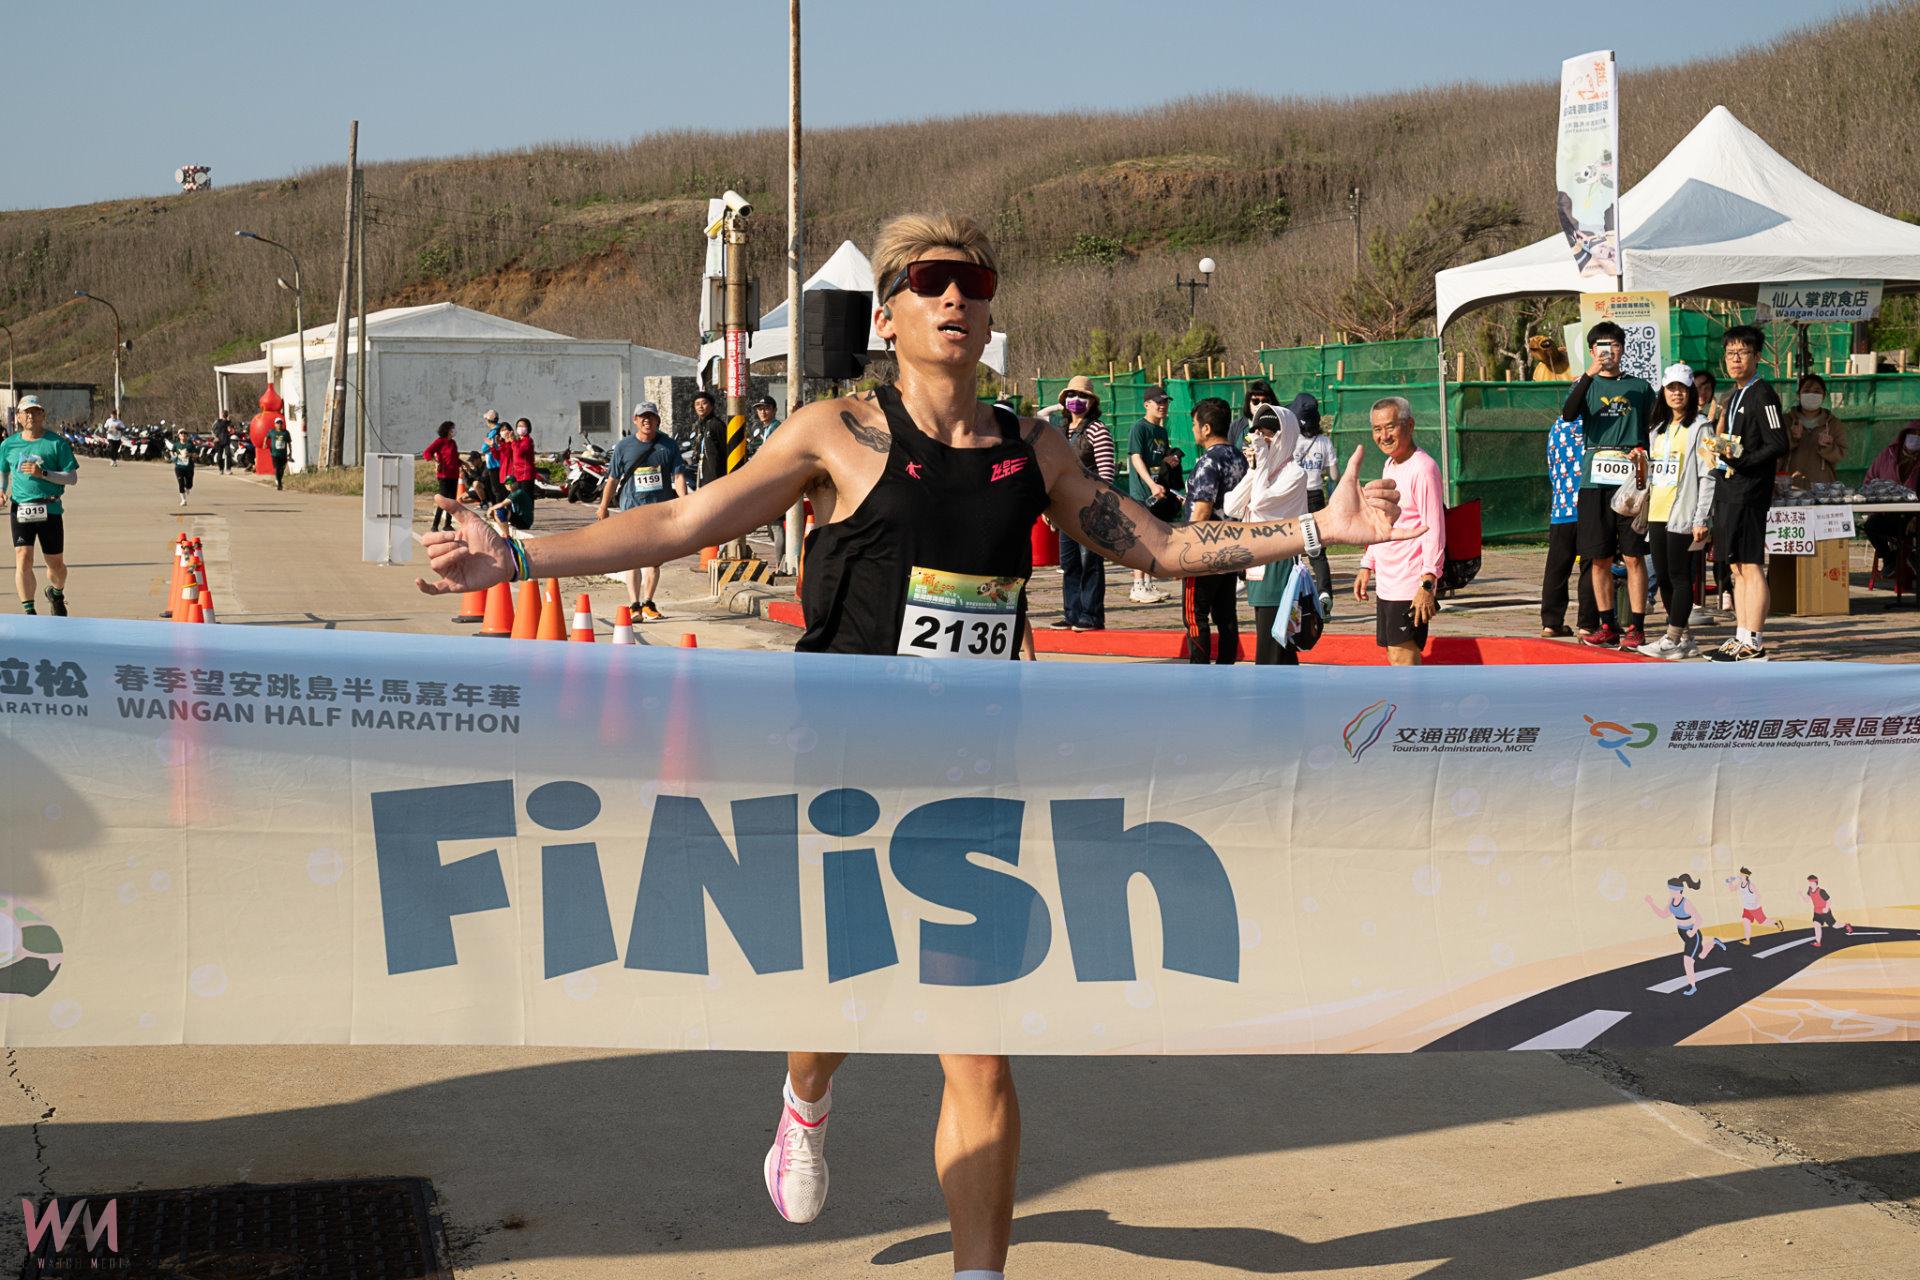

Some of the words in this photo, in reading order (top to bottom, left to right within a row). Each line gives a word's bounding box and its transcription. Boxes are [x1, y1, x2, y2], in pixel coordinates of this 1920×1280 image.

[1772, 290, 1869, 308] 仙人掌飲食店
[1775, 309, 1815, 319] Wangan
[1816, 308, 1838, 317] local
[1841, 307, 1862, 317] food
[1596, 463, 1629, 475] 1008
[637, 475, 660, 483] 1159
[910, 615, 1008, 655] 2136
[115, 664, 521, 708] 春季望安跳島半馬嘉年華
[117, 697, 254, 723] WANGAN
[265, 704, 342, 727] HALF
[351, 708, 520, 734] MARATHON
[1674, 720, 1711, 730] 交通部
[1708, 716, 1920, 740] 澎湖國家風景區管理
[1393, 727, 1541, 743] 交通部觀光署
[1392, 744, 1429, 752] Tourism
[1431, 744, 1503, 753] Administration,
[1505, 744, 1534, 752] MOTC
[1668, 742, 1696, 750] Penghu
[1776, 740, 1831, 749] Headquarters,
